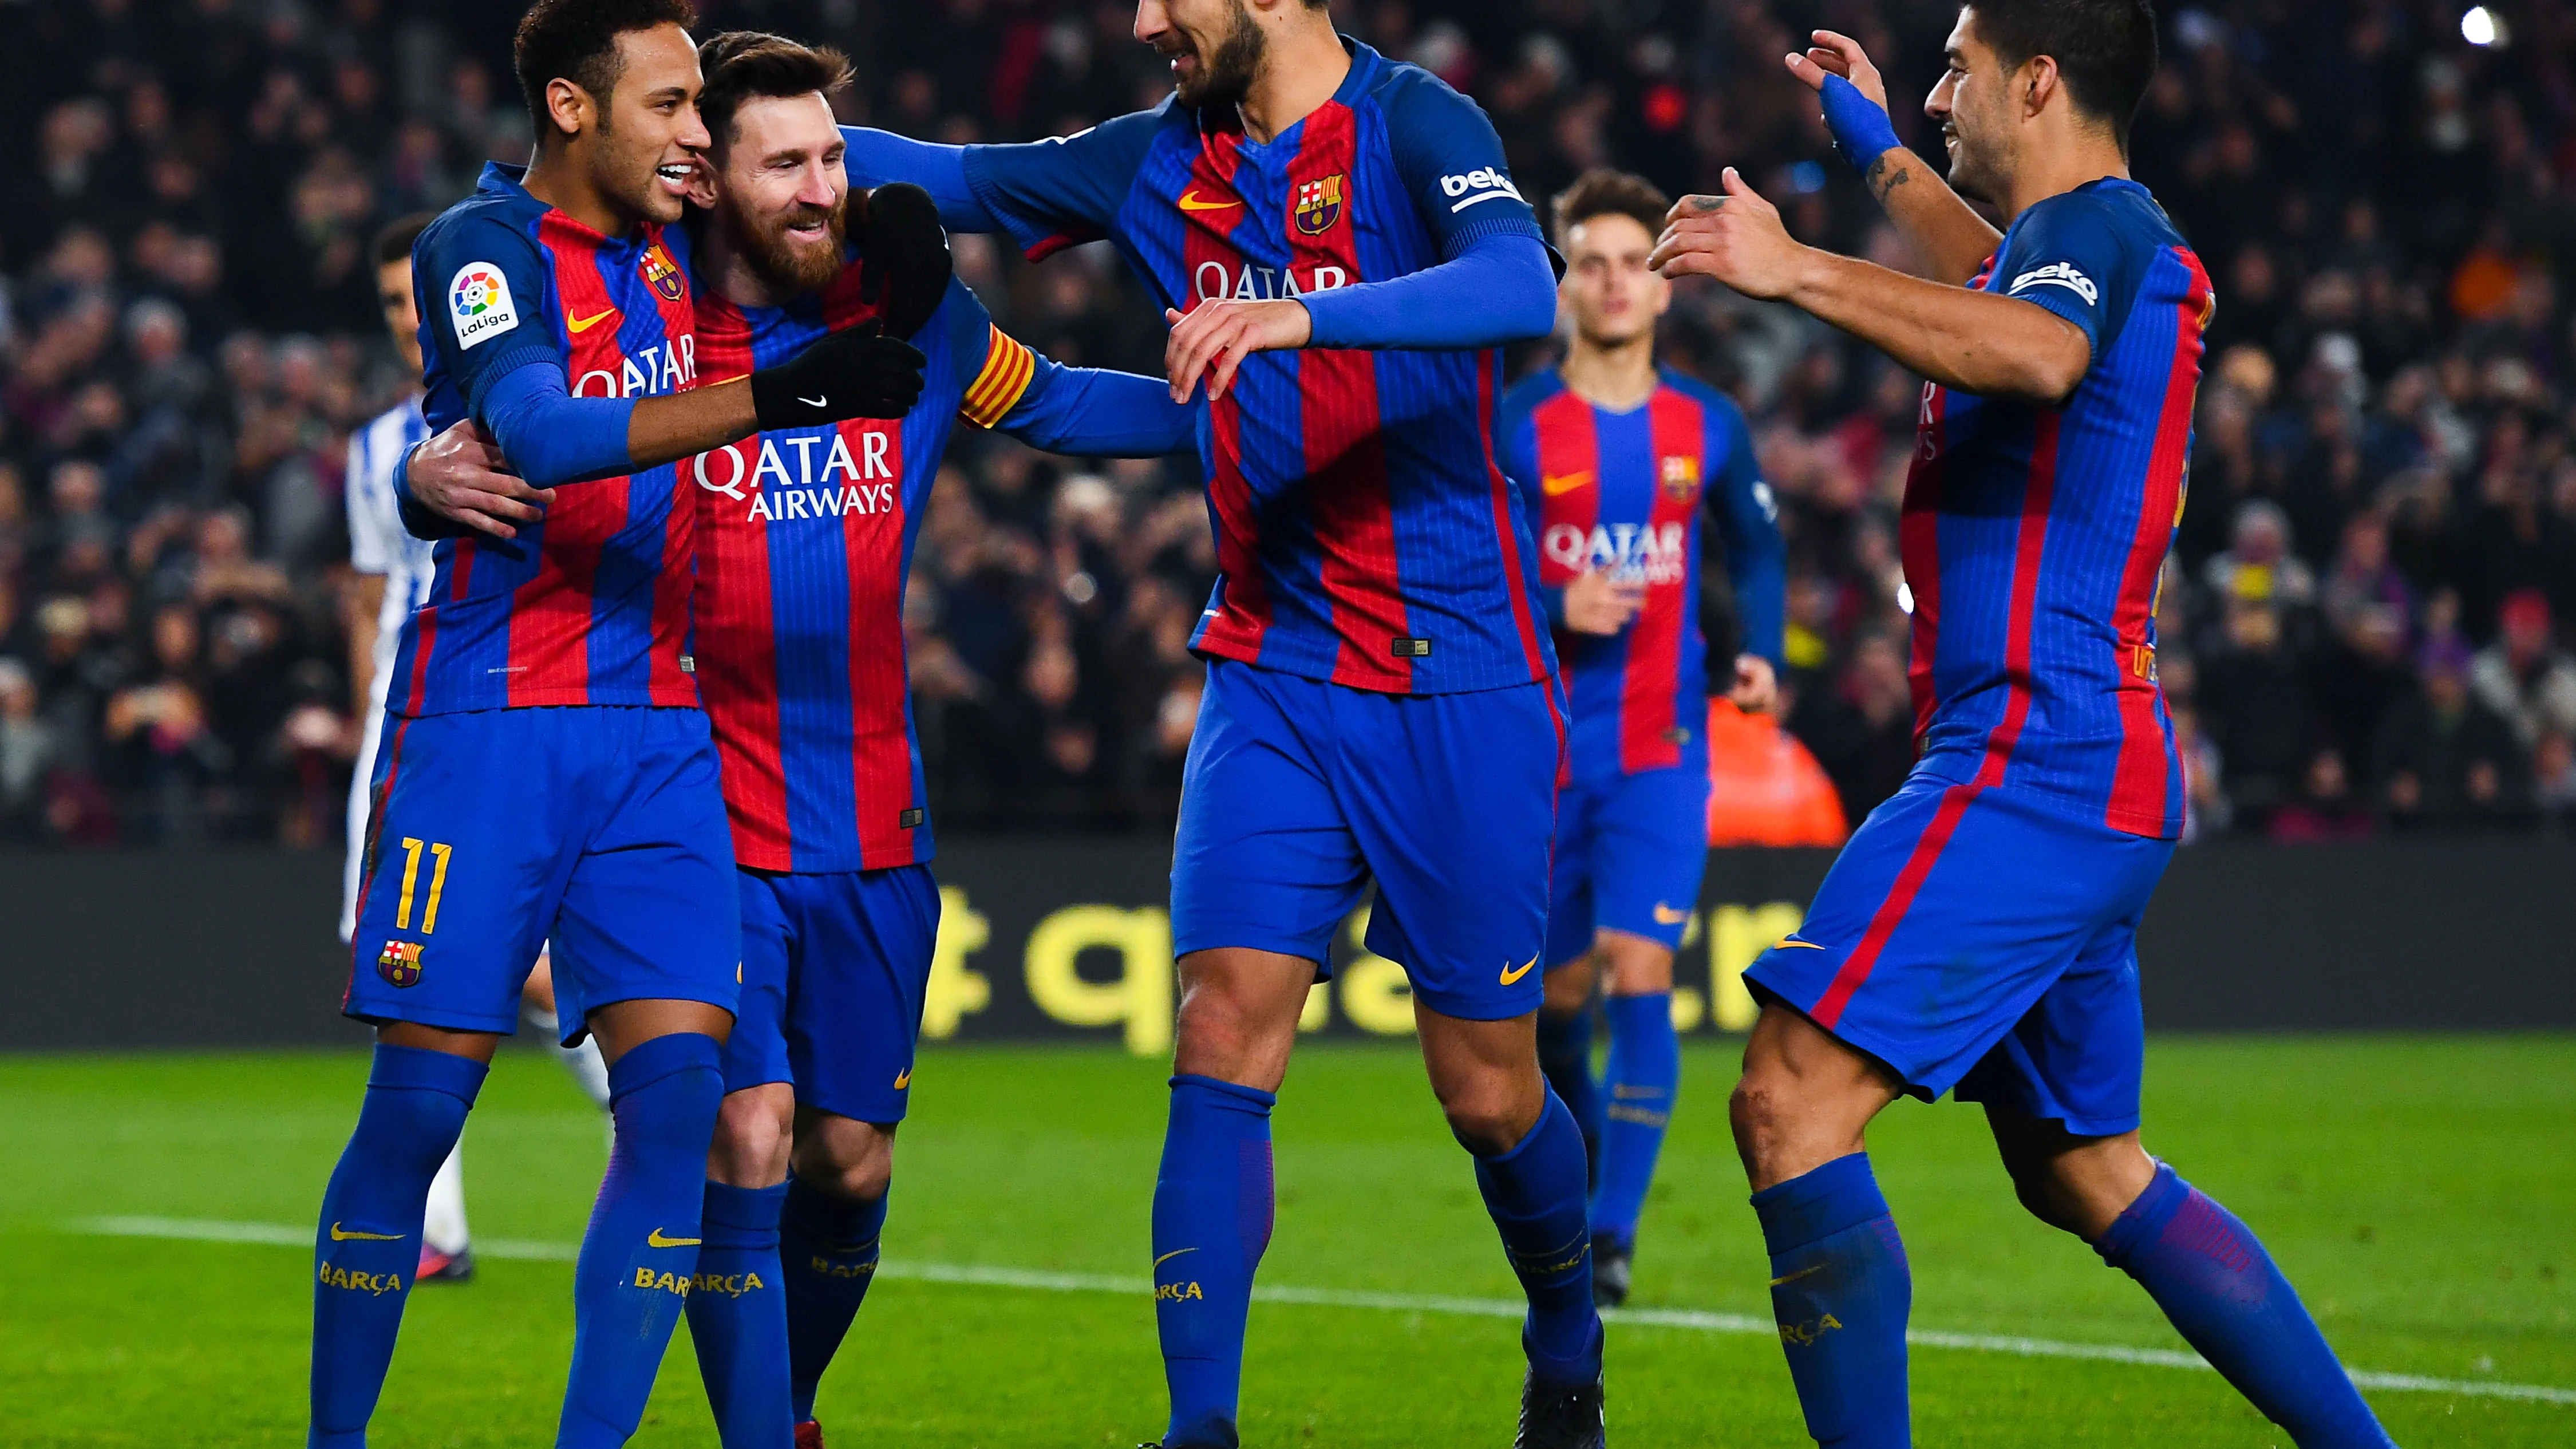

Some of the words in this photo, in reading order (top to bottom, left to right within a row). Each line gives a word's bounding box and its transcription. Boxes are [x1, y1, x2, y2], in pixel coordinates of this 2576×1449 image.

[2010, 262, 2098, 300] beko
[461, 313, 509, 337] LaLiga
[694, 432, 893, 501] QATAR
[747, 483, 893, 522] AIRWAYS
[1543, 520, 1684, 574] QATAR
[397, 837, 452, 934] 11
[320, 1261, 401, 1297] BARÇA
[634, 1267, 691, 1297] BAR
[690, 1273, 764, 1298] ARÇA
[1154, 1282, 1203, 1302] ARÇA
[1779, 1314, 1842, 1346] RÇA
